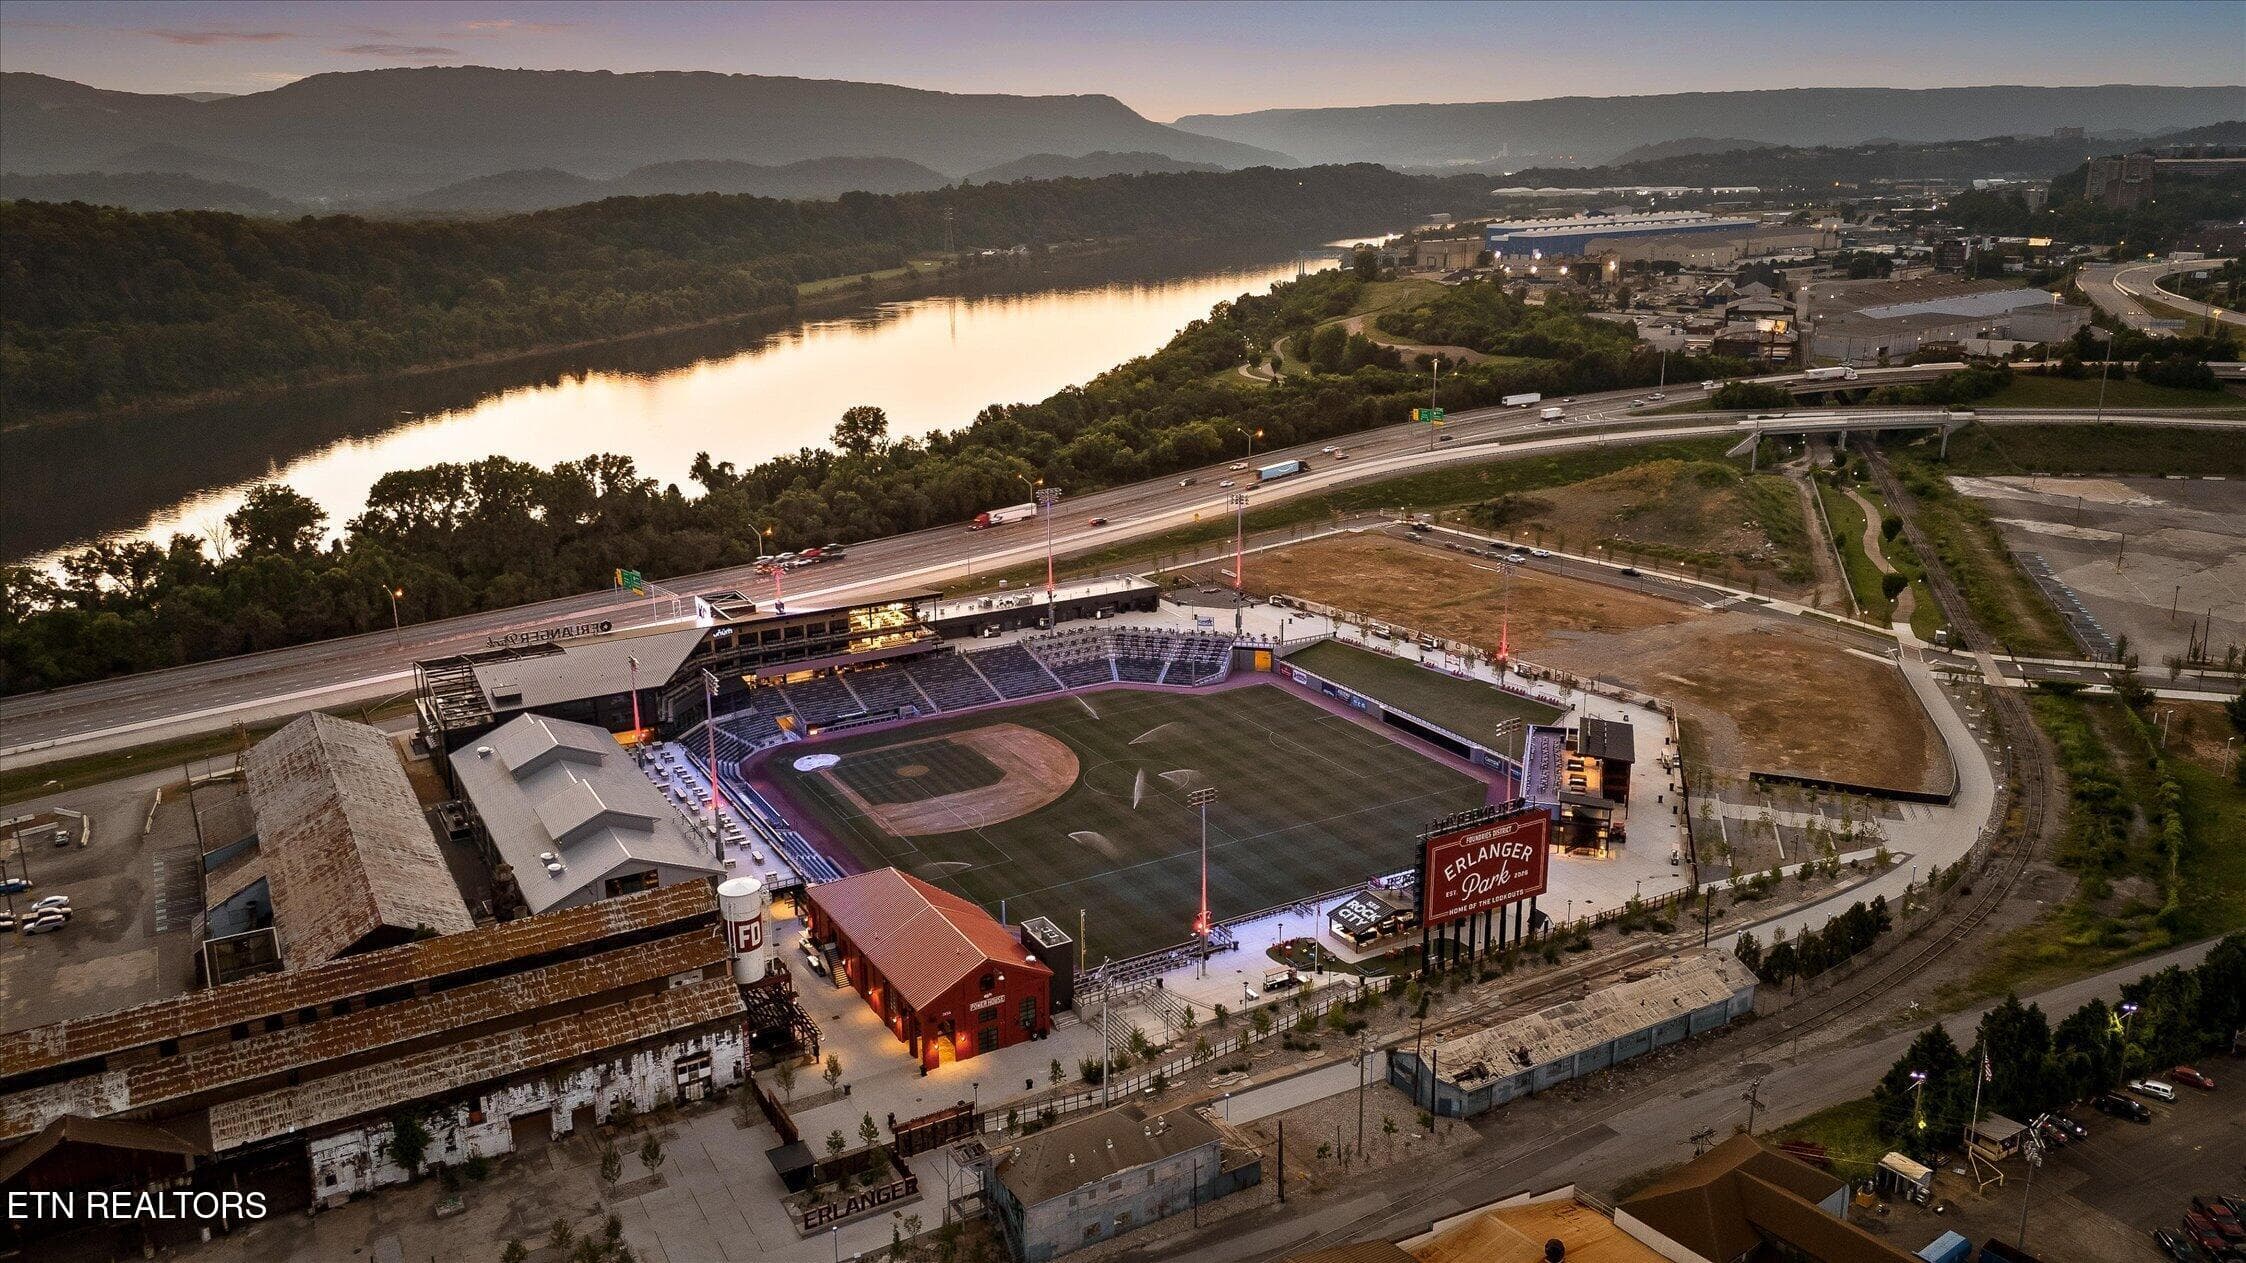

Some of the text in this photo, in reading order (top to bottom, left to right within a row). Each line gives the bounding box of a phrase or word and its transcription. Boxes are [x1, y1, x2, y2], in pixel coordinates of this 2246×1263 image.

[1466, 825, 1512, 844] FOUNDRIES DISTRICT
[1444, 842, 1533, 882] ERLANGER
[1461, 860, 1511, 901] Park
[1346, 900, 1381, 922] ROCK
[1449, 888, 1524, 916] HOME OF THE LOOKOUTS
[1338, 909, 1369, 926] CITY
[739, 921, 761, 949] FD
[803, 1175, 919, 1230] ERLANGER
